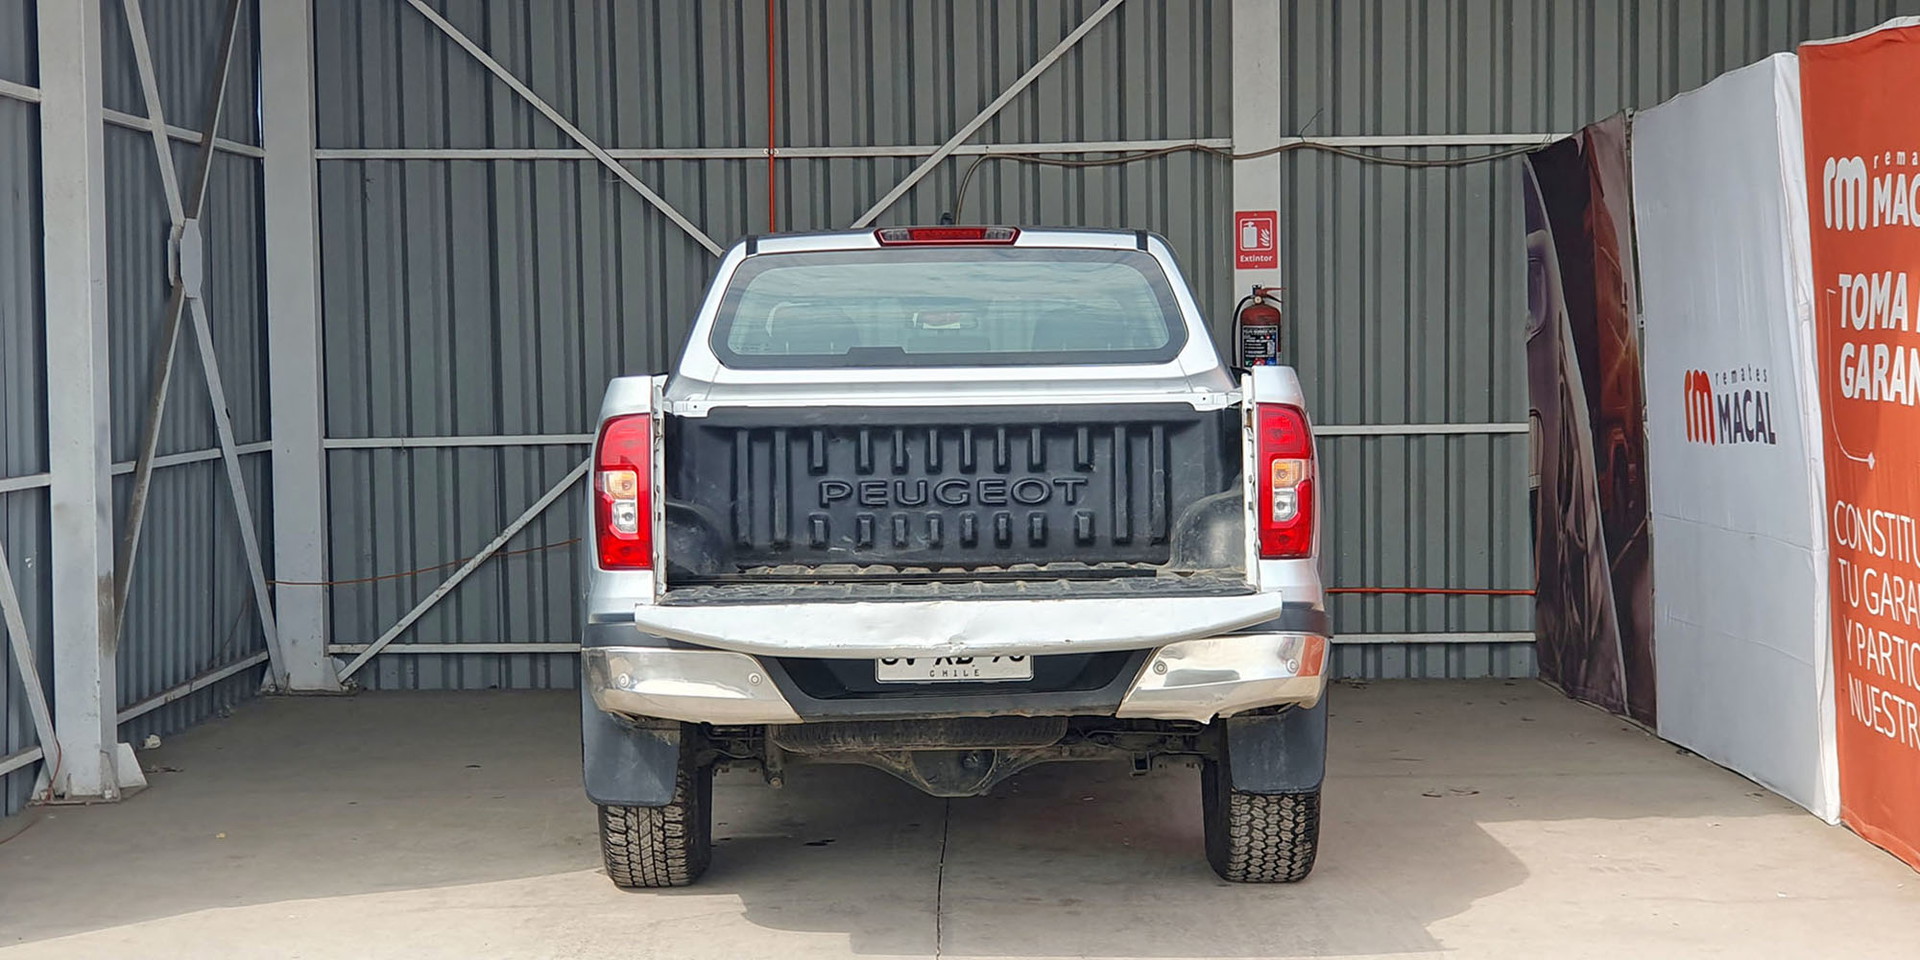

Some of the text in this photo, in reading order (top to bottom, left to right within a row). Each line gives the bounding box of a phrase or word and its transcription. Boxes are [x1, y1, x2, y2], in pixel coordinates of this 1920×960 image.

[1240, 254, 1273, 263] Extintor
[1838, 271, 1909, 332] TOMA
[1715, 363, 1768, 386] remates
[1717, 389, 1777, 445] MACAL
[818, 478, 1090, 508] PEUGEOT
[1838, 557, 1920, 630] TU GARA
[1843, 614, 1853, 661] Y
[929, 668, 980, 678] CHILE
